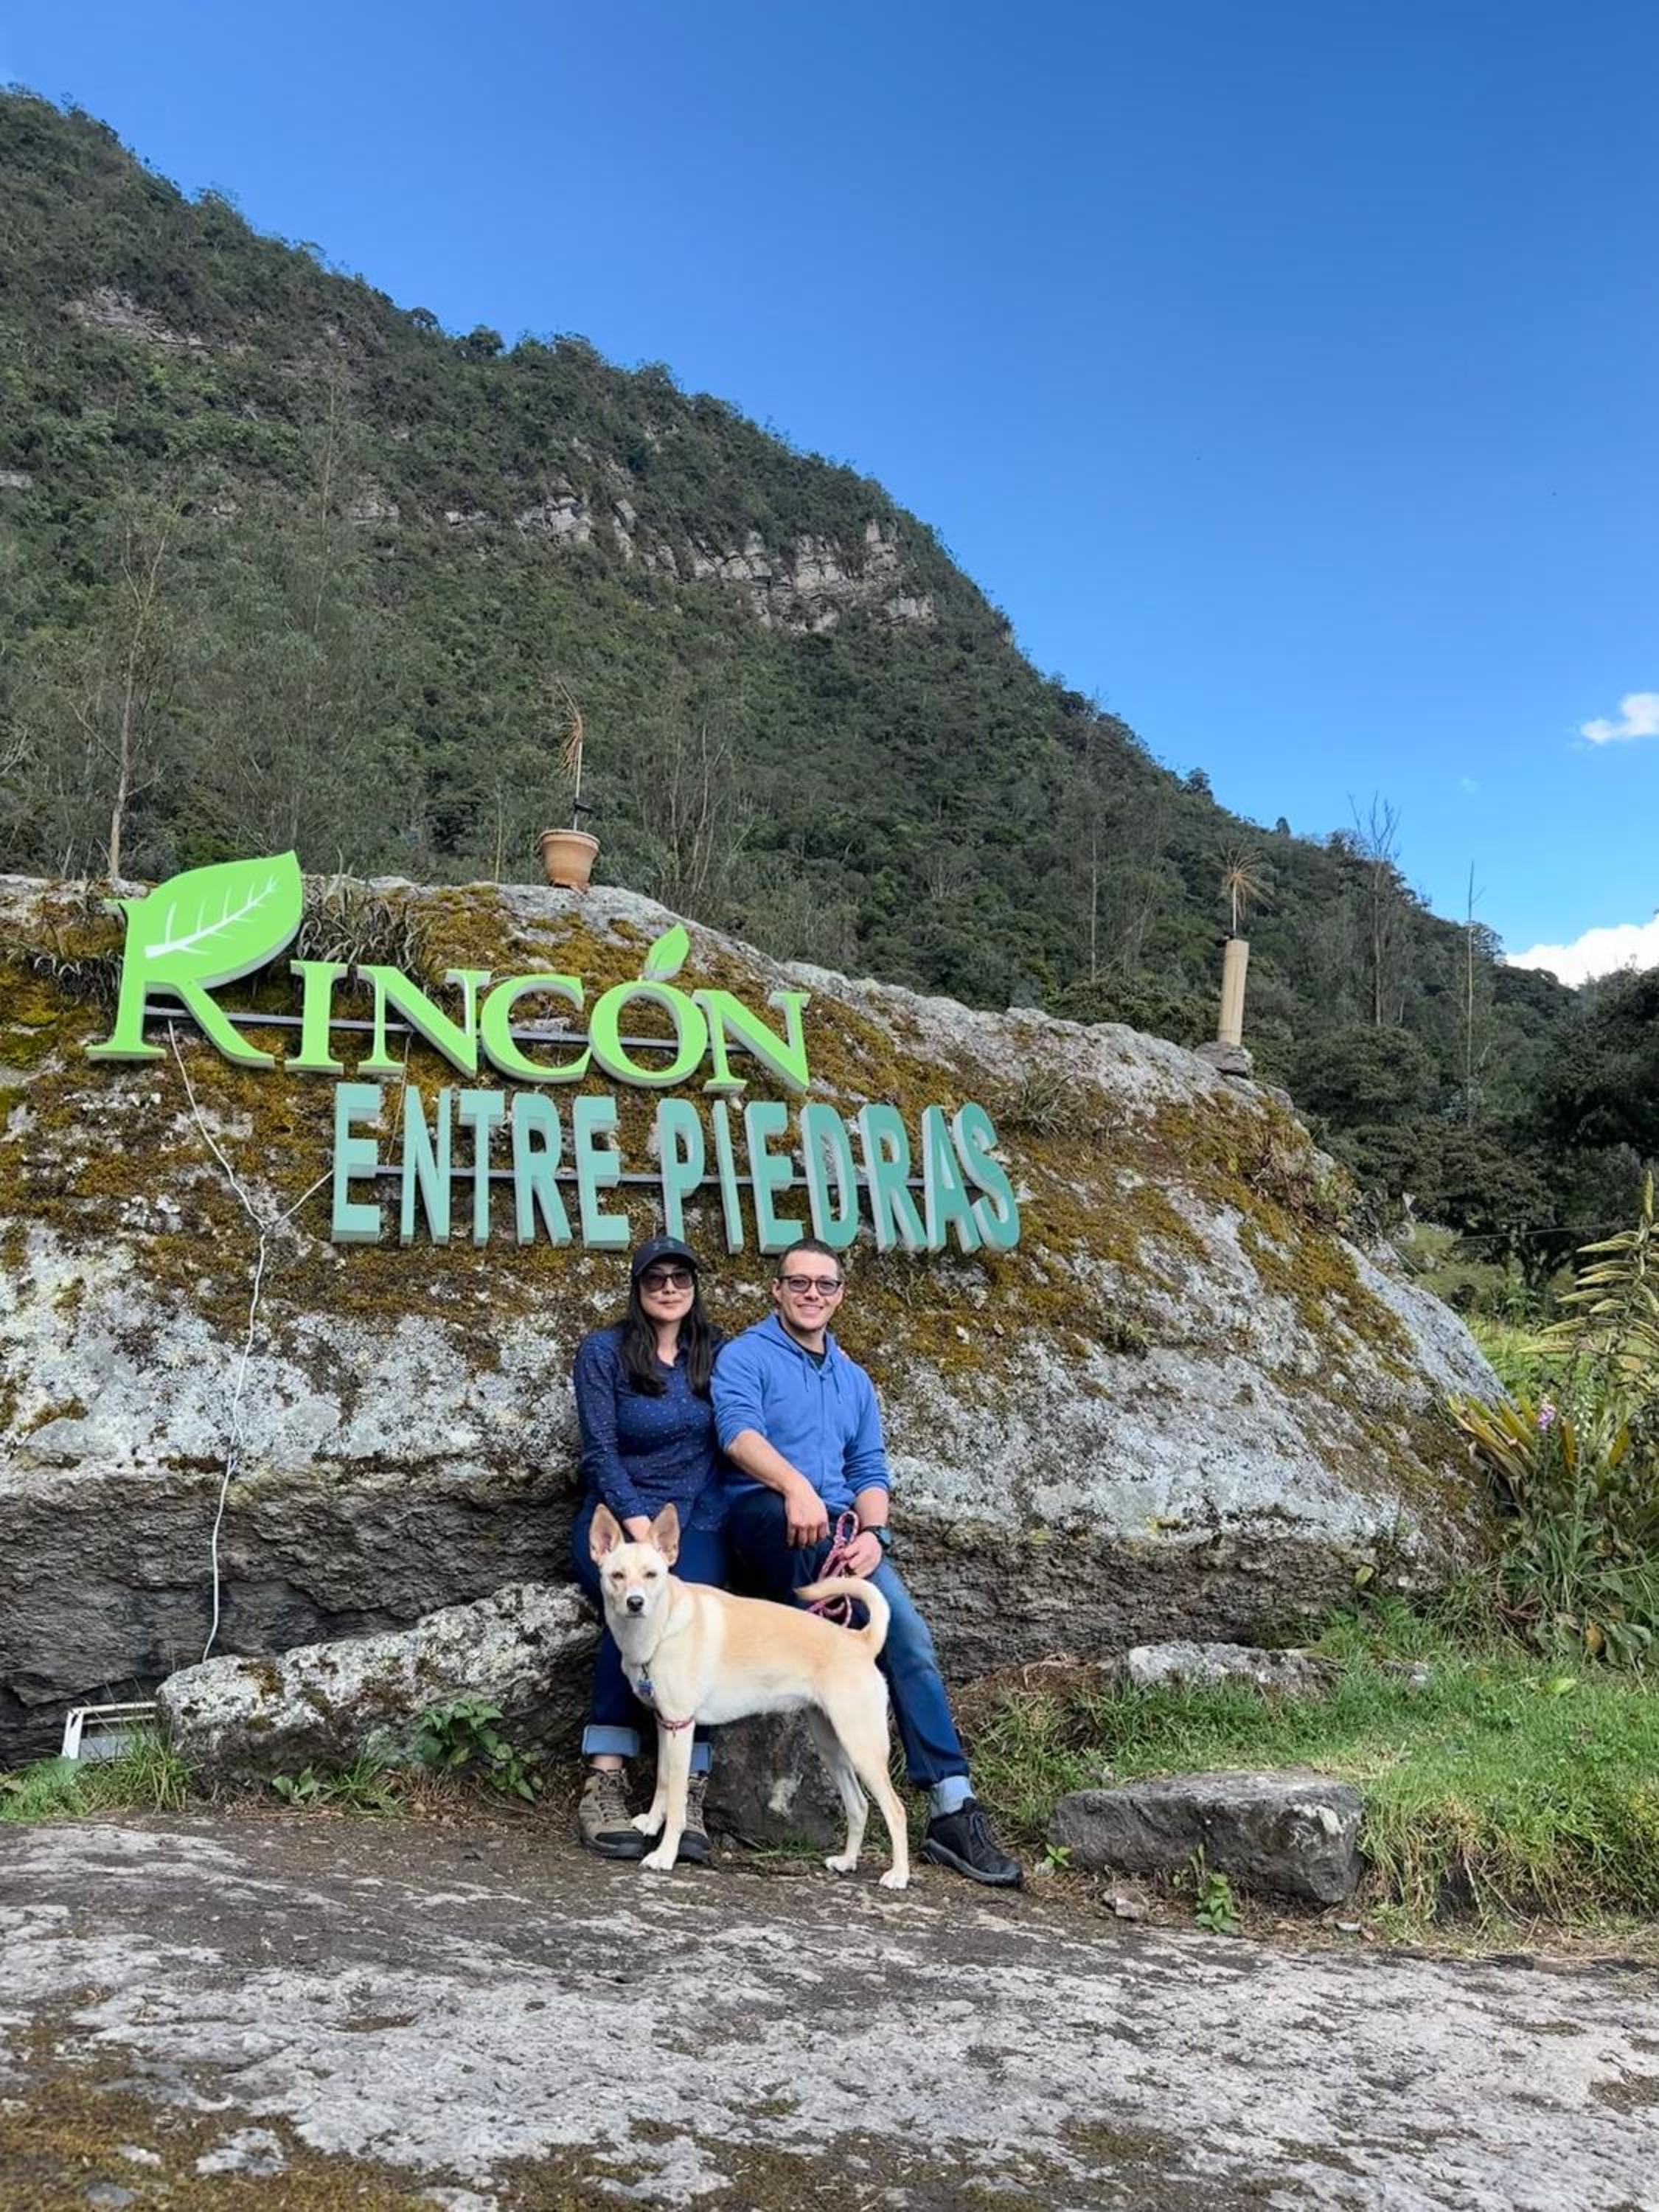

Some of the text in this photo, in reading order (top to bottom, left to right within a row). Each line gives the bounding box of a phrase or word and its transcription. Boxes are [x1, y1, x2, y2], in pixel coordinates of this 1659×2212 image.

[86, 850, 811, 1093] RINCÓN
[330, 1082, 1020, 1253] ENTRE PIEDRAS
